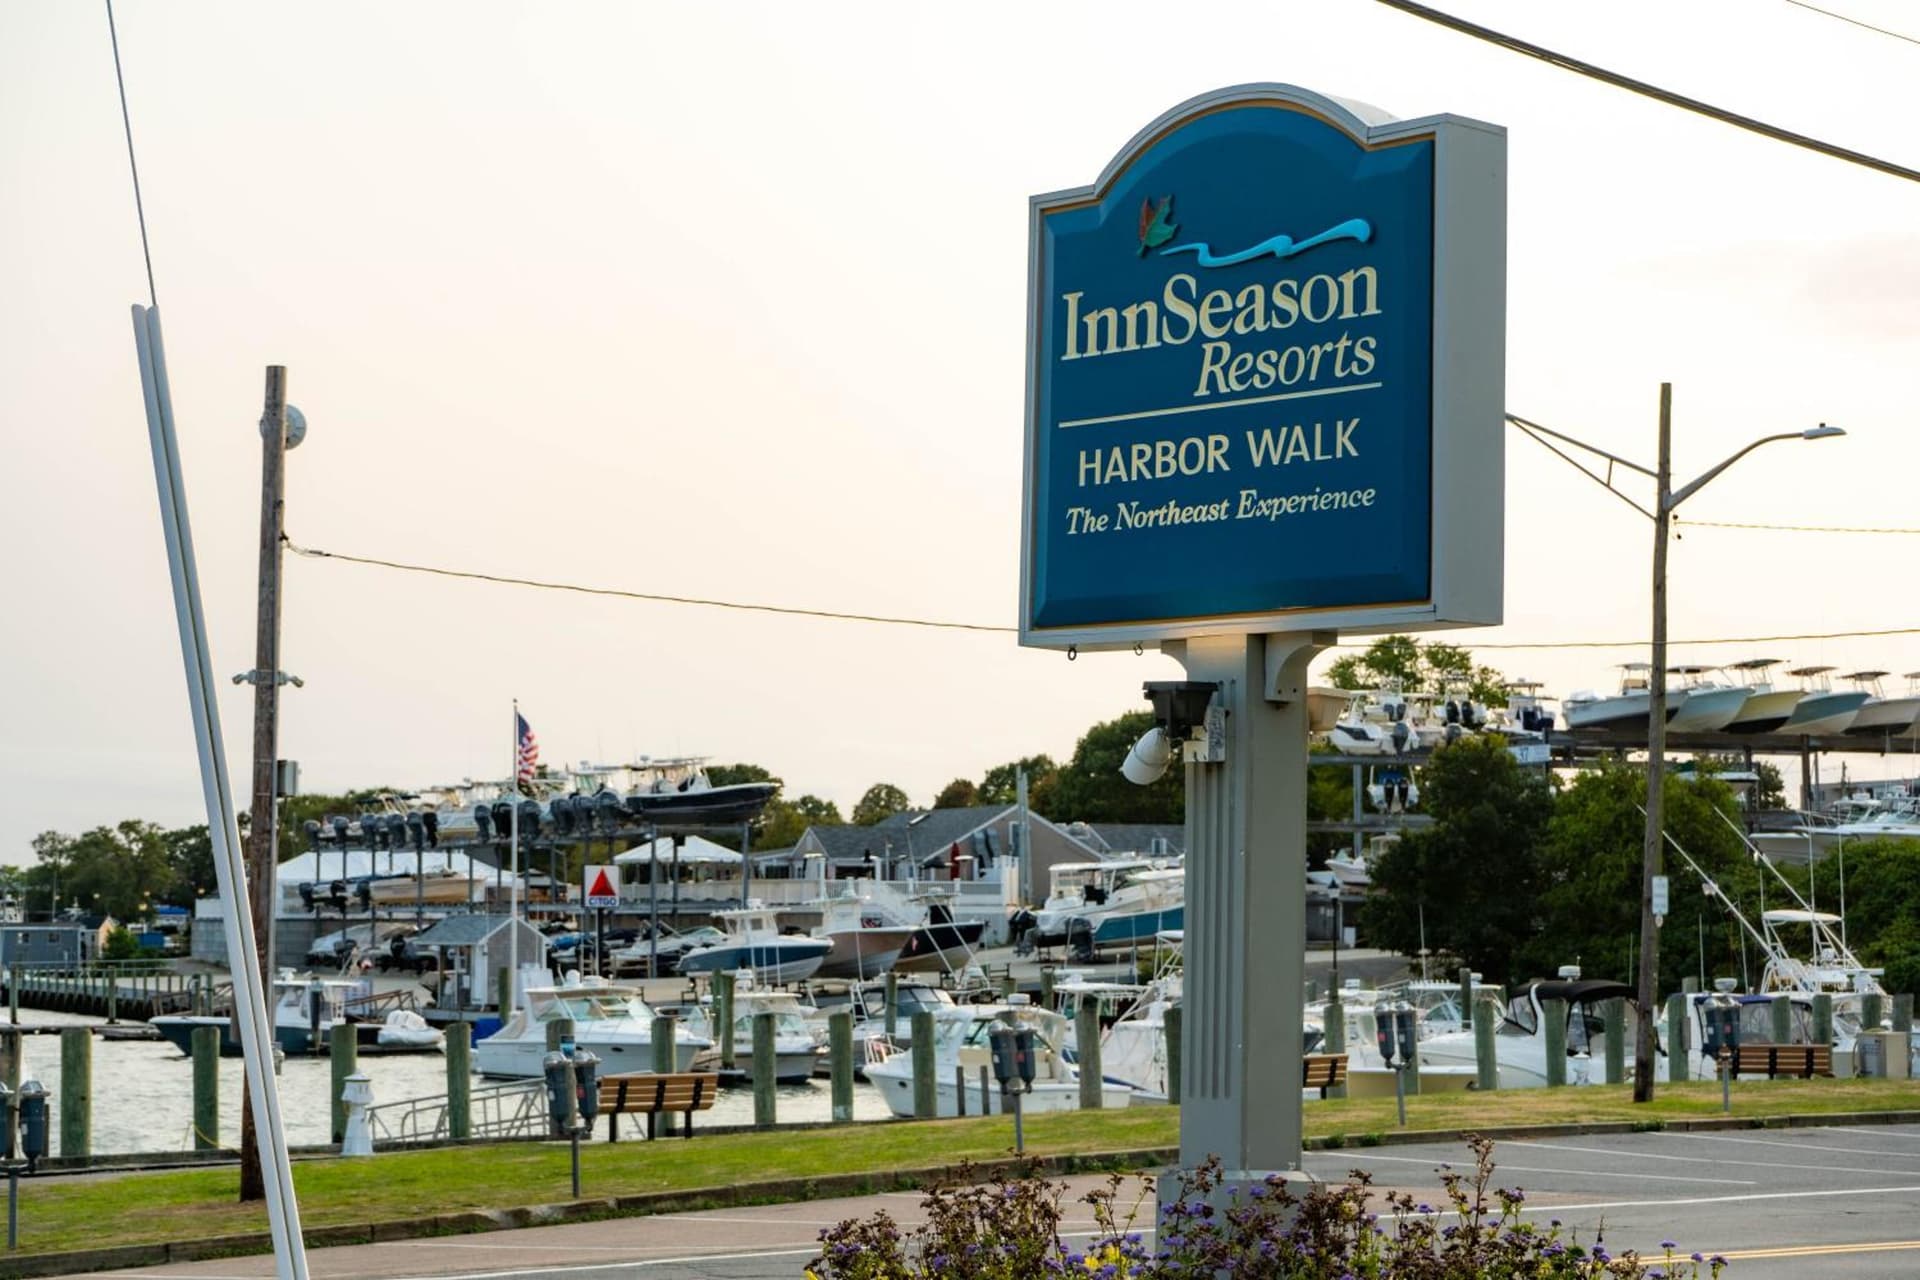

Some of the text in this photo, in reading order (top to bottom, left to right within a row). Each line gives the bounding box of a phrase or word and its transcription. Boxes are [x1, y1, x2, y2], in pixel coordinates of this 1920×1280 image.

[1061, 266, 1382, 361] InnSeason
[1194, 334, 1376, 396] Resorts
[1078, 419, 1361, 486] HARBOR WALK
[1066, 488, 1376, 535] The Northeast Experience
